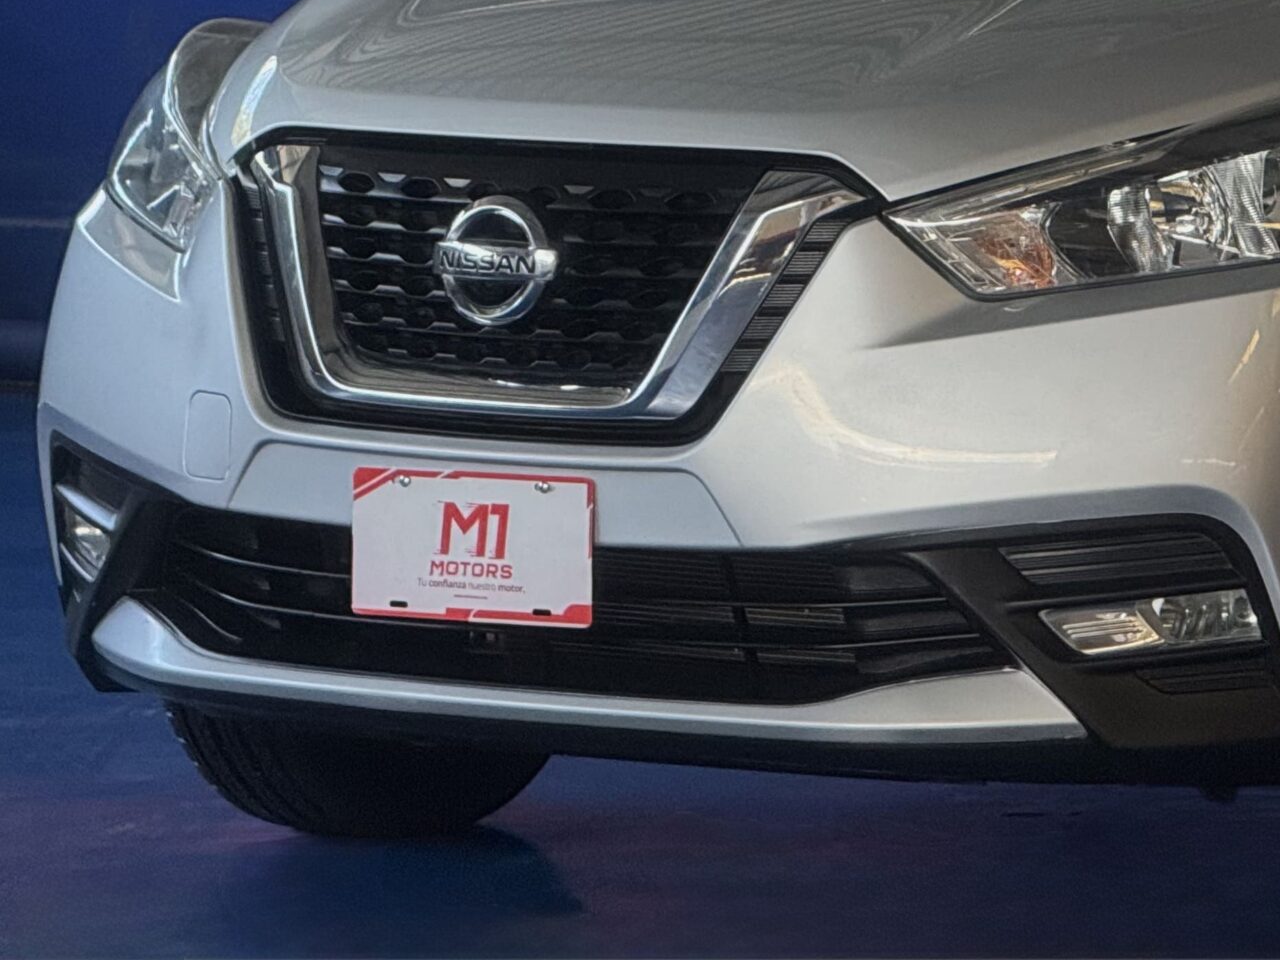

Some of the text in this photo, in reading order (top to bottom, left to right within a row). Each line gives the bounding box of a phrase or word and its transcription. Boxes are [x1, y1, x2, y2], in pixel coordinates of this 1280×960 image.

[440, 250, 536, 274] NISSAN
[436, 501, 509, 560] M1
[429, 560, 513, 579] MOTORS
[417, 577, 427, 587] Tu
[428, 578, 467, 589] confianza
[468, 581, 497, 591] nuestro
